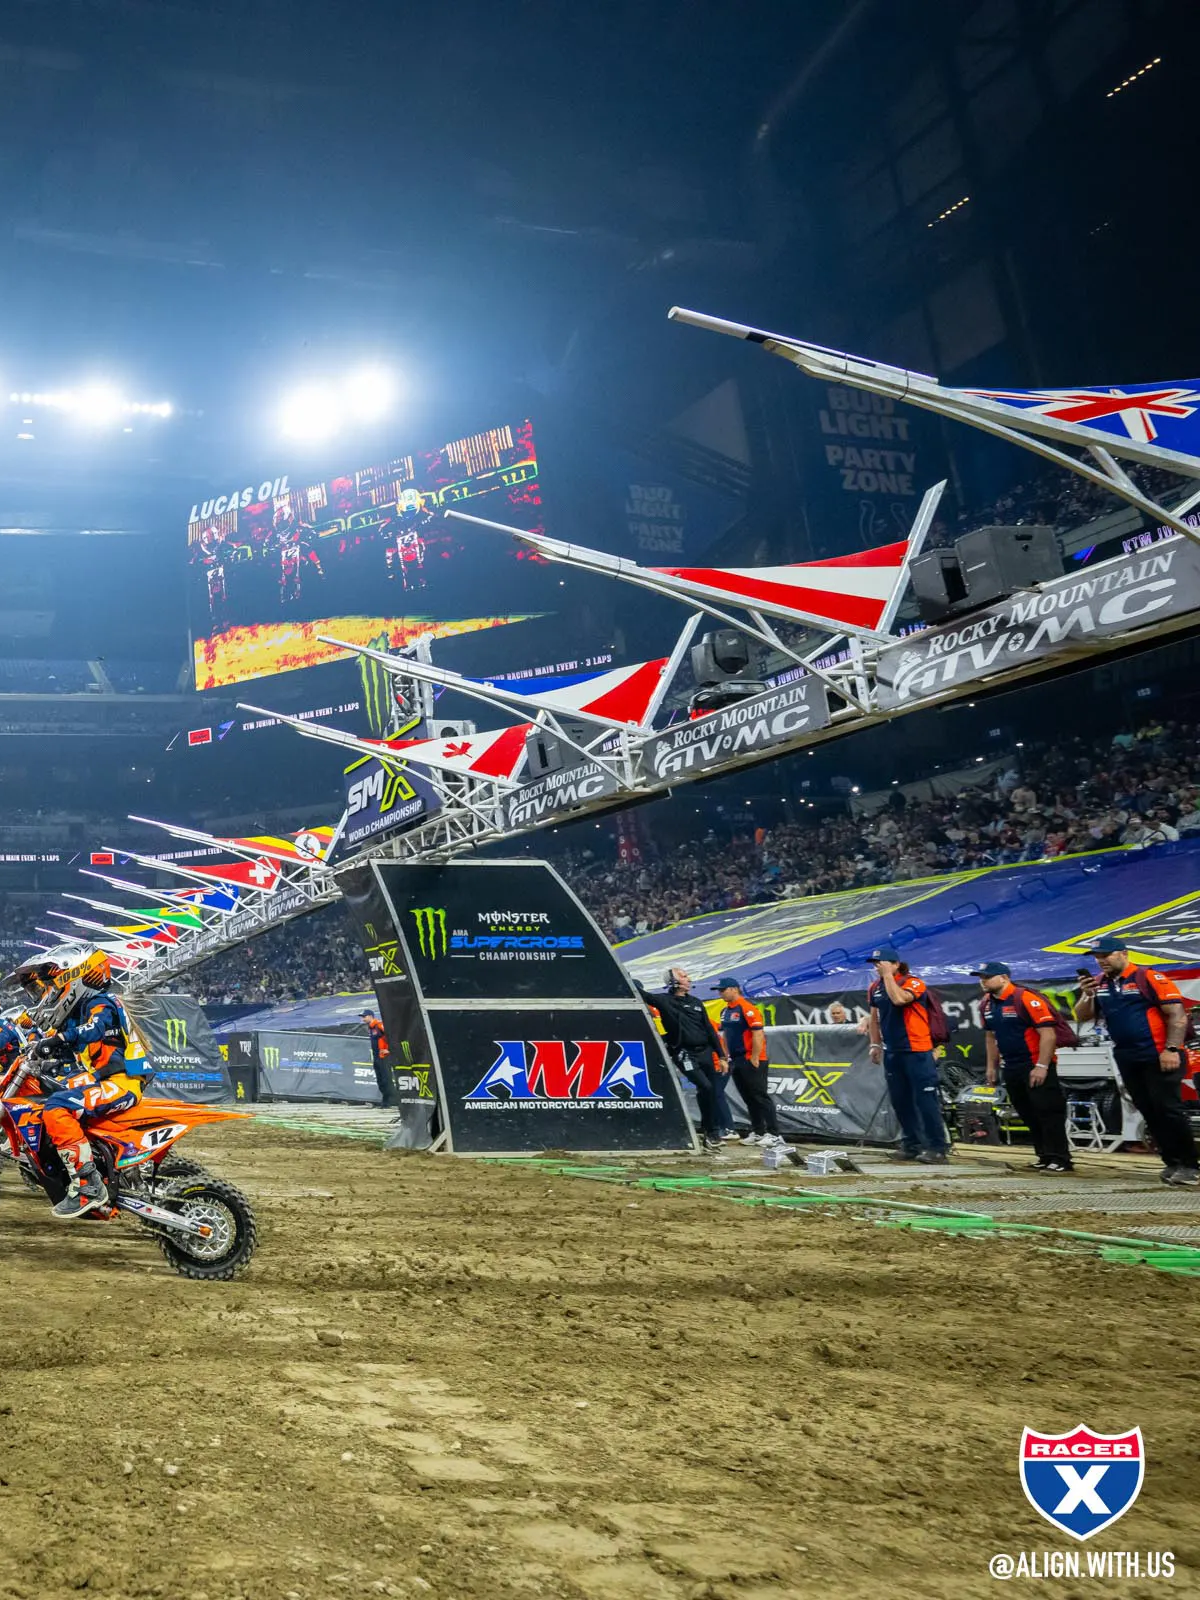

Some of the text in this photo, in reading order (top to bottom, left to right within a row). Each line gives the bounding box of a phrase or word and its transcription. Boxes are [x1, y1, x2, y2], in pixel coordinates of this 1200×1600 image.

[819, 410, 910, 441] LIGHT
[825, 445, 916, 473] PARTY
[840, 469, 916, 495] ZONE
[189, 475, 290, 524] LUCAS OIL
[927, 550, 1176, 658] ROCKY MOUNTAIN
[534, 665, 555, 676] MAIN
[556, 660, 578, 672] EVENT
[593, 654, 612, 665] LAPS
[316, 706, 333, 717] EVENT
[344, 702, 360, 712] LAPS
[673, 685, 807, 749] ROCKY MOUNTAIN
[349, 757, 417, 816] SMX
[519, 762, 601, 803] ROCKY MOUNTAIN
[349, 799, 423, 842] WORLD CHAMPIONSHIP
[478, 910, 550, 924] MONSTER
[451, 936, 584, 948] SUPERCROSS
[368, 948, 402, 976] SMX
[479, 952, 556, 960] CHAMPIONSHIP
[56, 960, 92, 987] 100%
[63, 990, 77, 1013] FLY
[154, 1056, 202, 1065] MONSTER
[461, 1041, 663, 1099] AMA
[398, 1070, 434, 1098] SMX
[464, 1101, 663, 1110] AMERICAN MOTORCYCLIST ASSOCIATION
[148, 1128, 174, 1146] 12
